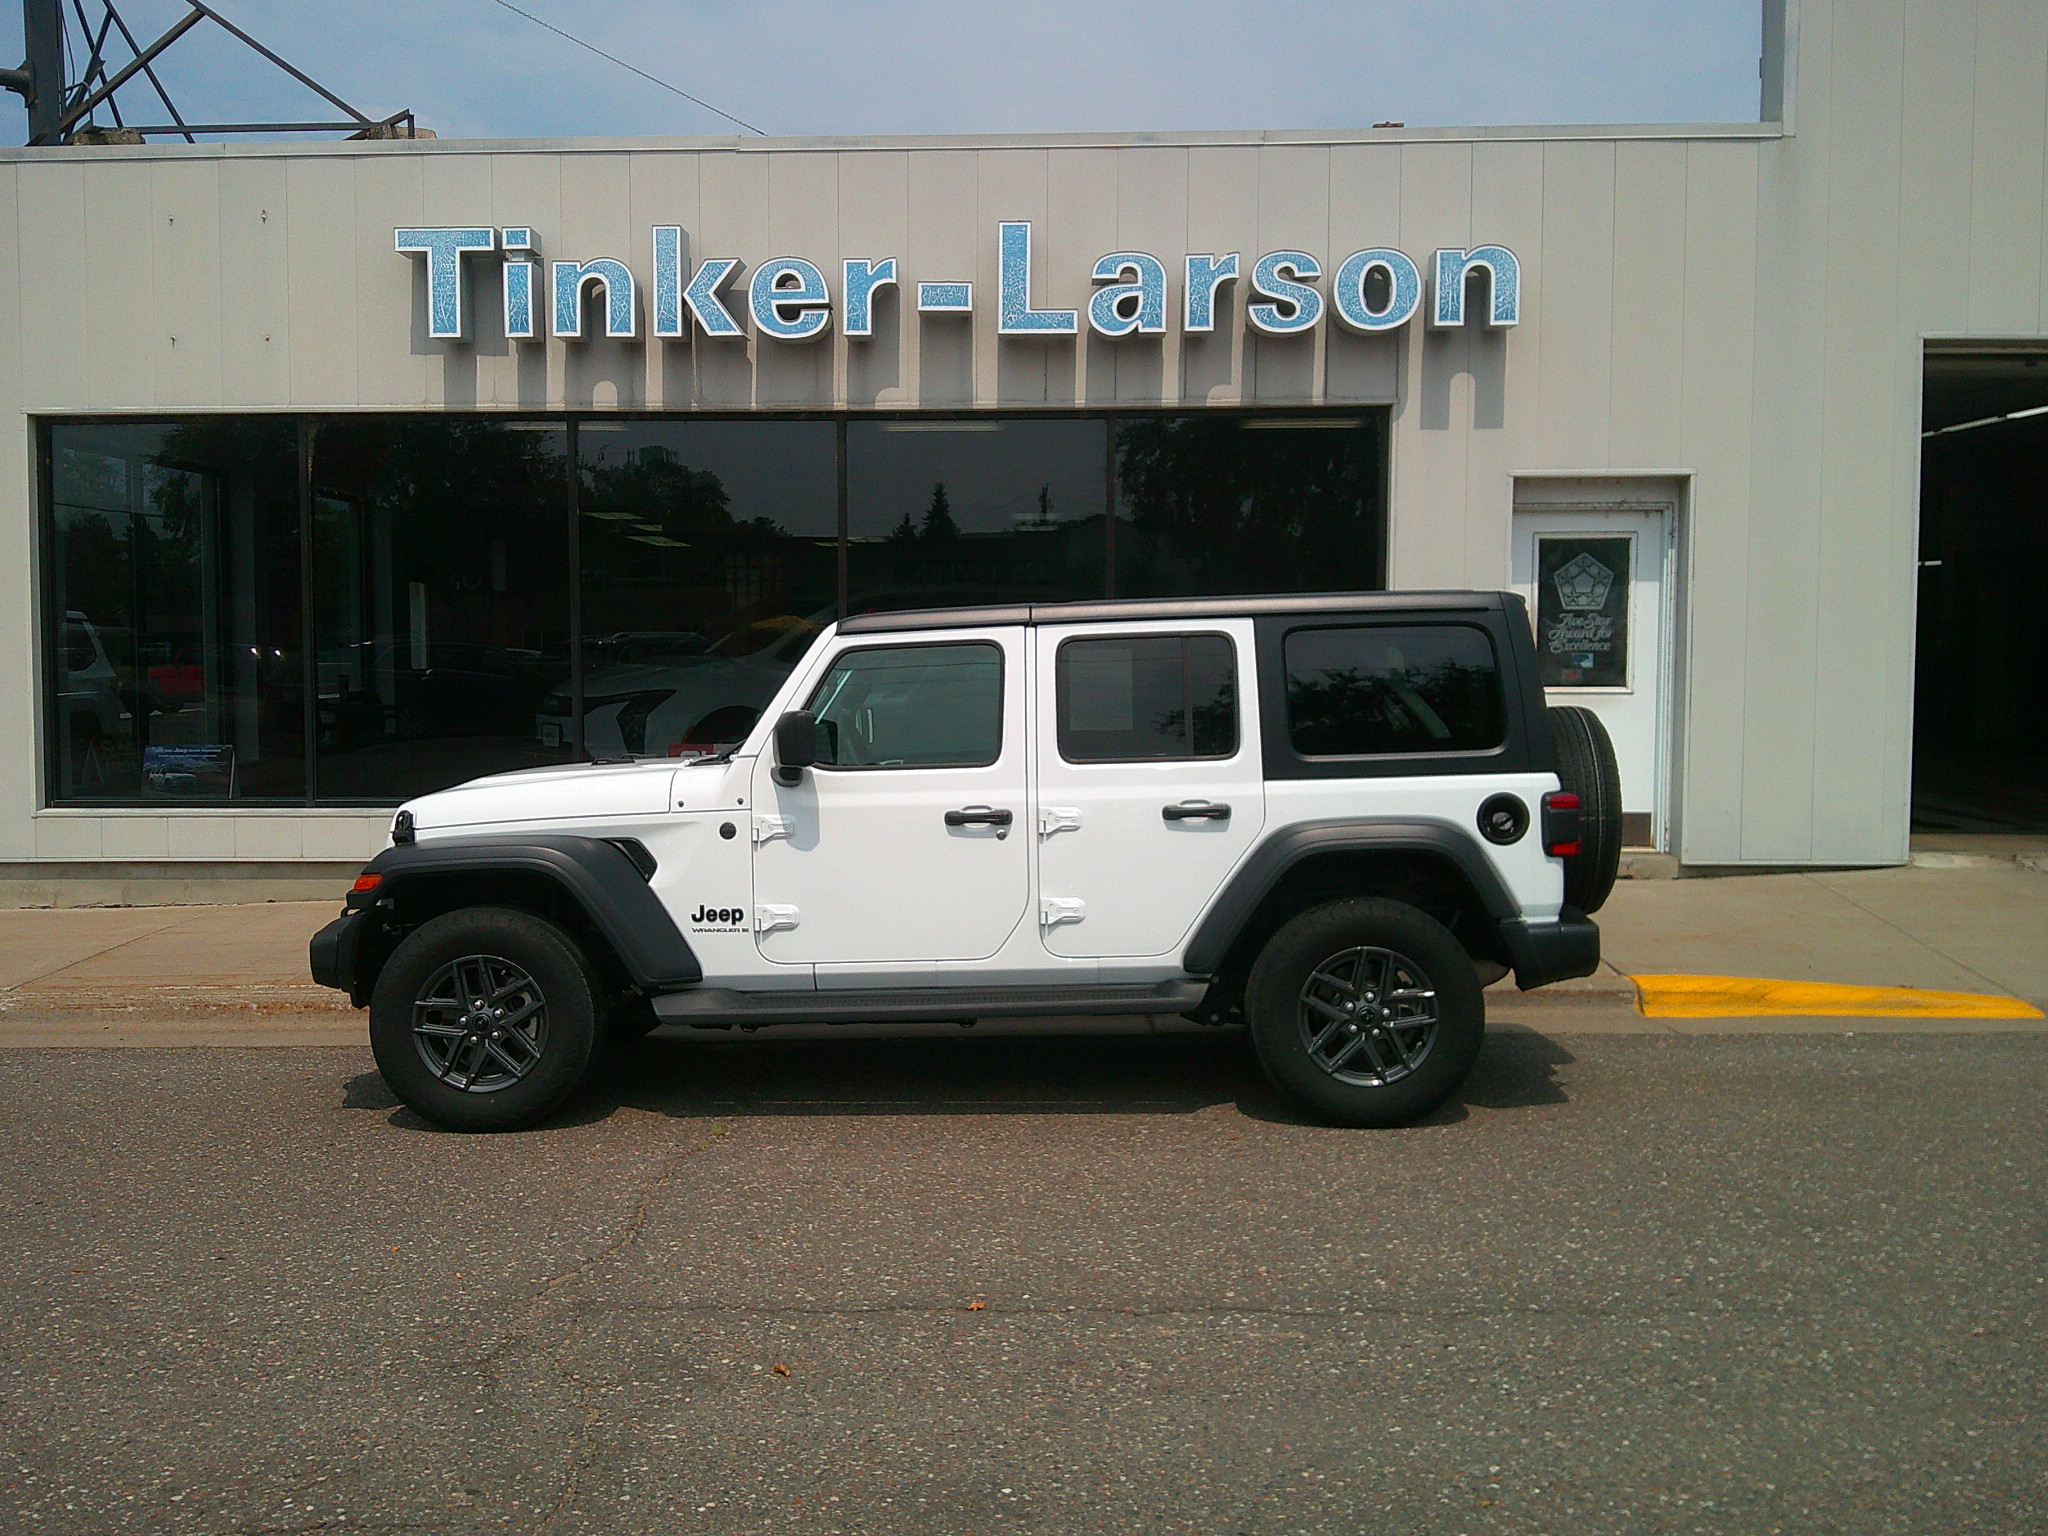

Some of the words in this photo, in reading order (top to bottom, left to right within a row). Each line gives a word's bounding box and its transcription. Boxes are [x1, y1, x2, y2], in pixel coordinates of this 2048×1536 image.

[1583, 613, 1613, 628] Star
[1548, 627, 1597, 640] Award
[1594, 626, 1614, 641] for
[1549, 638, 1611, 654] Excellence
[691, 904, 744, 926] Jeep
